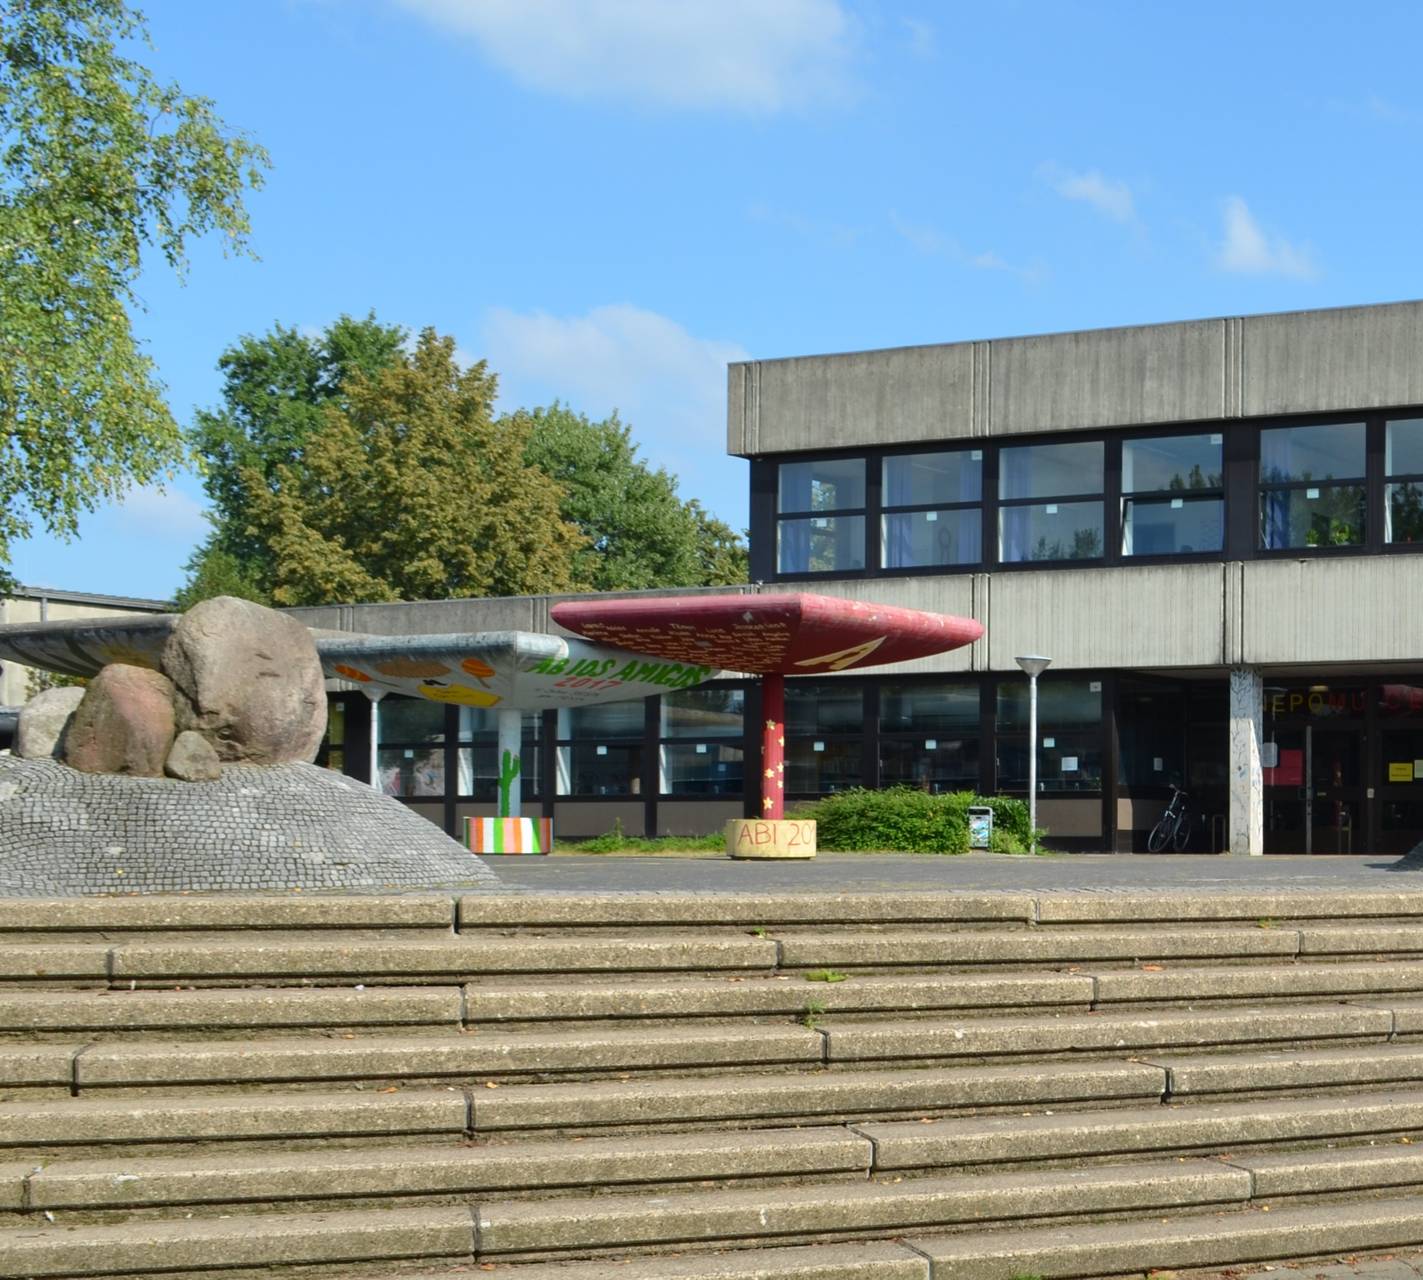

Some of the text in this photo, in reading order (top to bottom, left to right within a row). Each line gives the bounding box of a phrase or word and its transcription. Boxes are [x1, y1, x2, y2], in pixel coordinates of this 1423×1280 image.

[554, 675, 623, 690] 2017
[613, 660, 713, 688] AMIGOS
[737, 822, 816, 846] ABI 20
